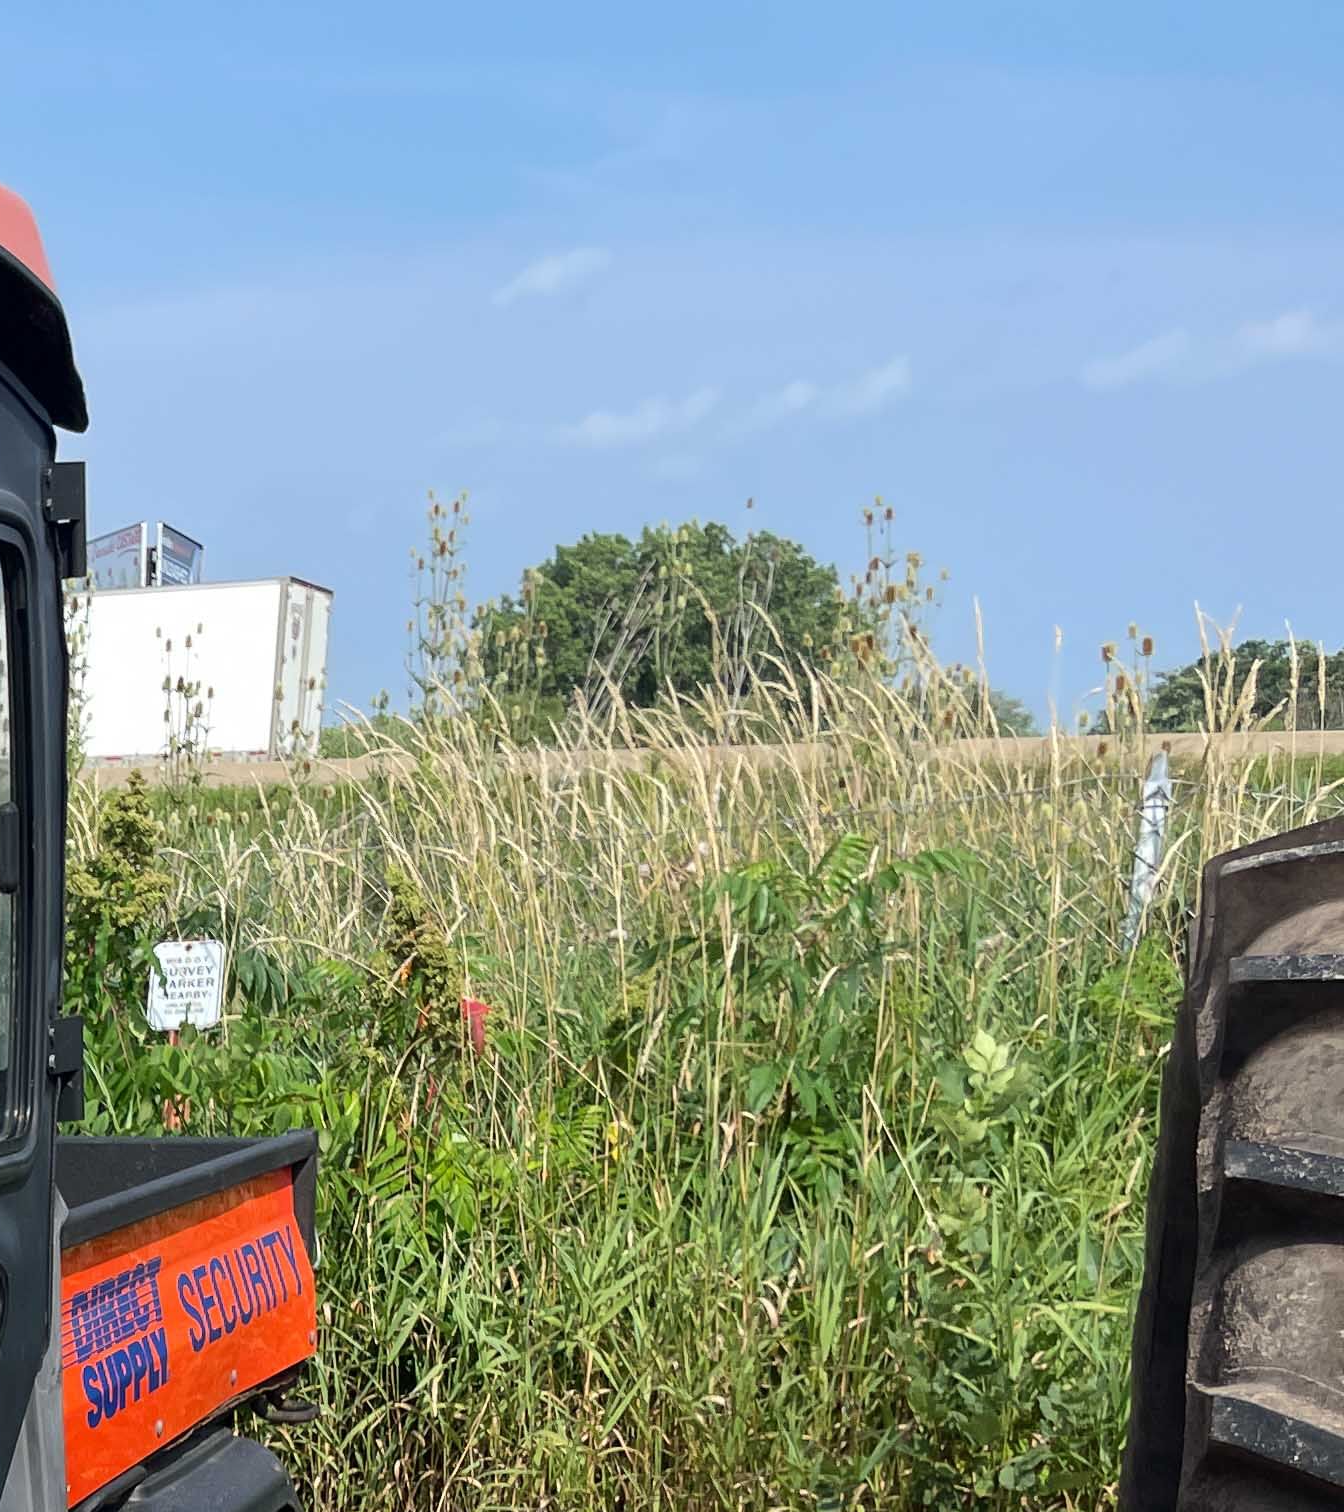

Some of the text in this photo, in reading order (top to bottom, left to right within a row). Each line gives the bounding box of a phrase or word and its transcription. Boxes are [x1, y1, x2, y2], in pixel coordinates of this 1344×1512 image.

[164, 977, 215, 989] ARKER
[70, 1256, 163, 1365] DIRECT
[176, 1224, 303, 1353] SECURITY
[80, 1327, 170, 1428] SUPPLY
